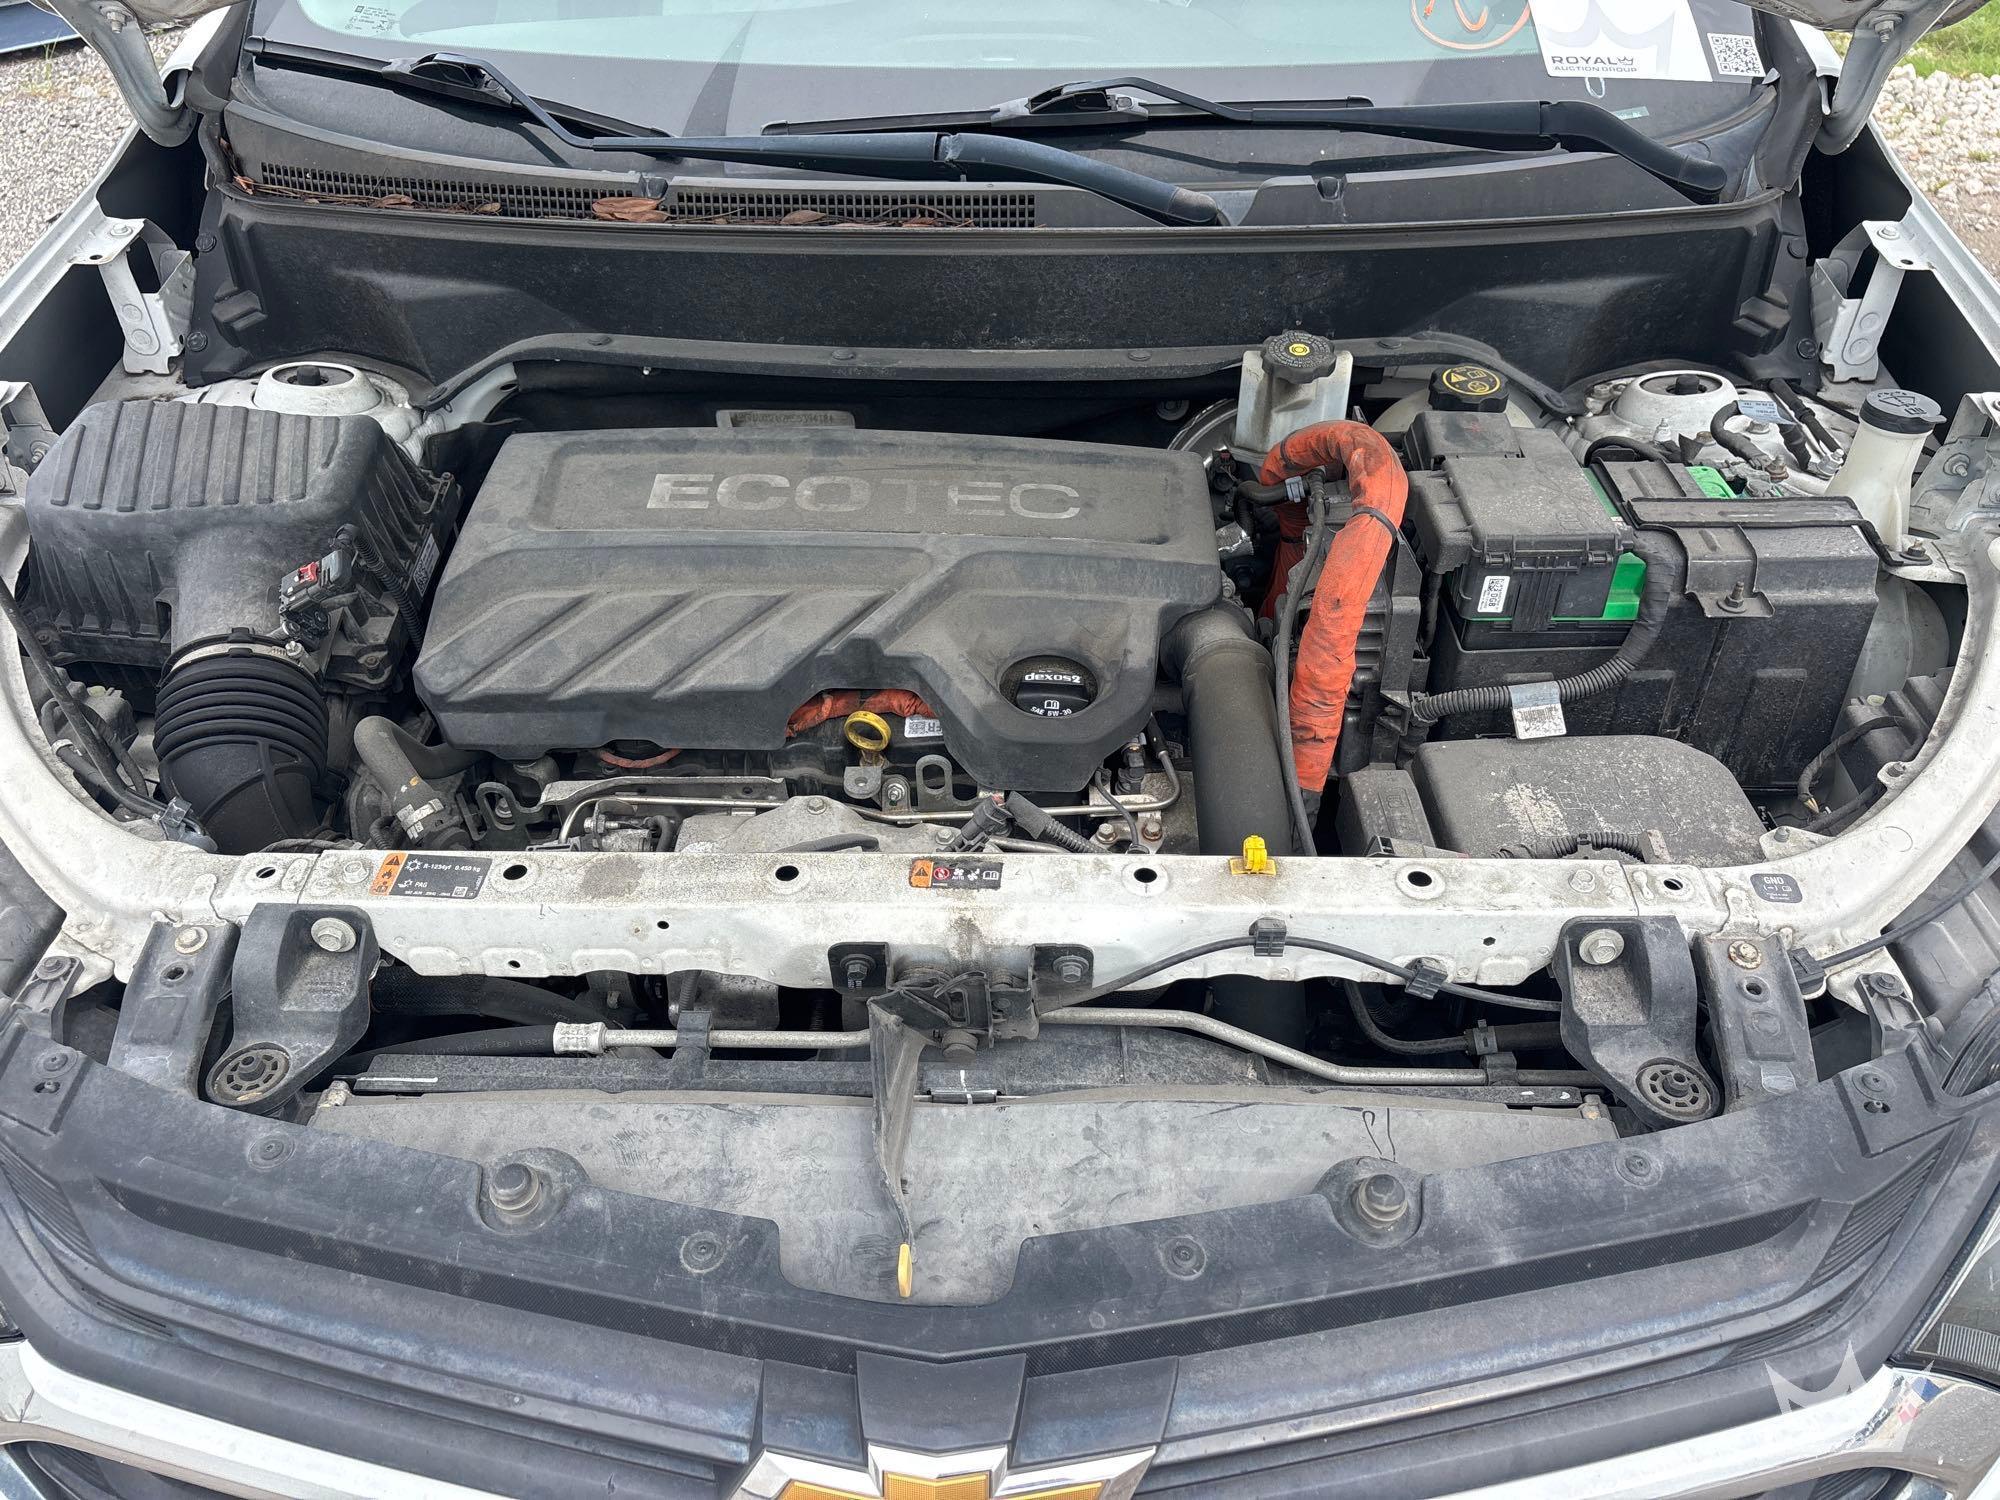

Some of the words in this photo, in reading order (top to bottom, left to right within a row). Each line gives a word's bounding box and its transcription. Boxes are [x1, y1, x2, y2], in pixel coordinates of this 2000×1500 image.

[1551, 56, 1617, 65] ROYAL
[646, 473, 1081, 520] ECOTEC
[1024, 672, 1082, 684] dexos2
[1030, 705, 1045, 716] SAE
[1047, 708, 1073, 717] 5W-30
[423, 863, 452, 871] R-1234yf
[1763, 876, 1784, 885] GND
